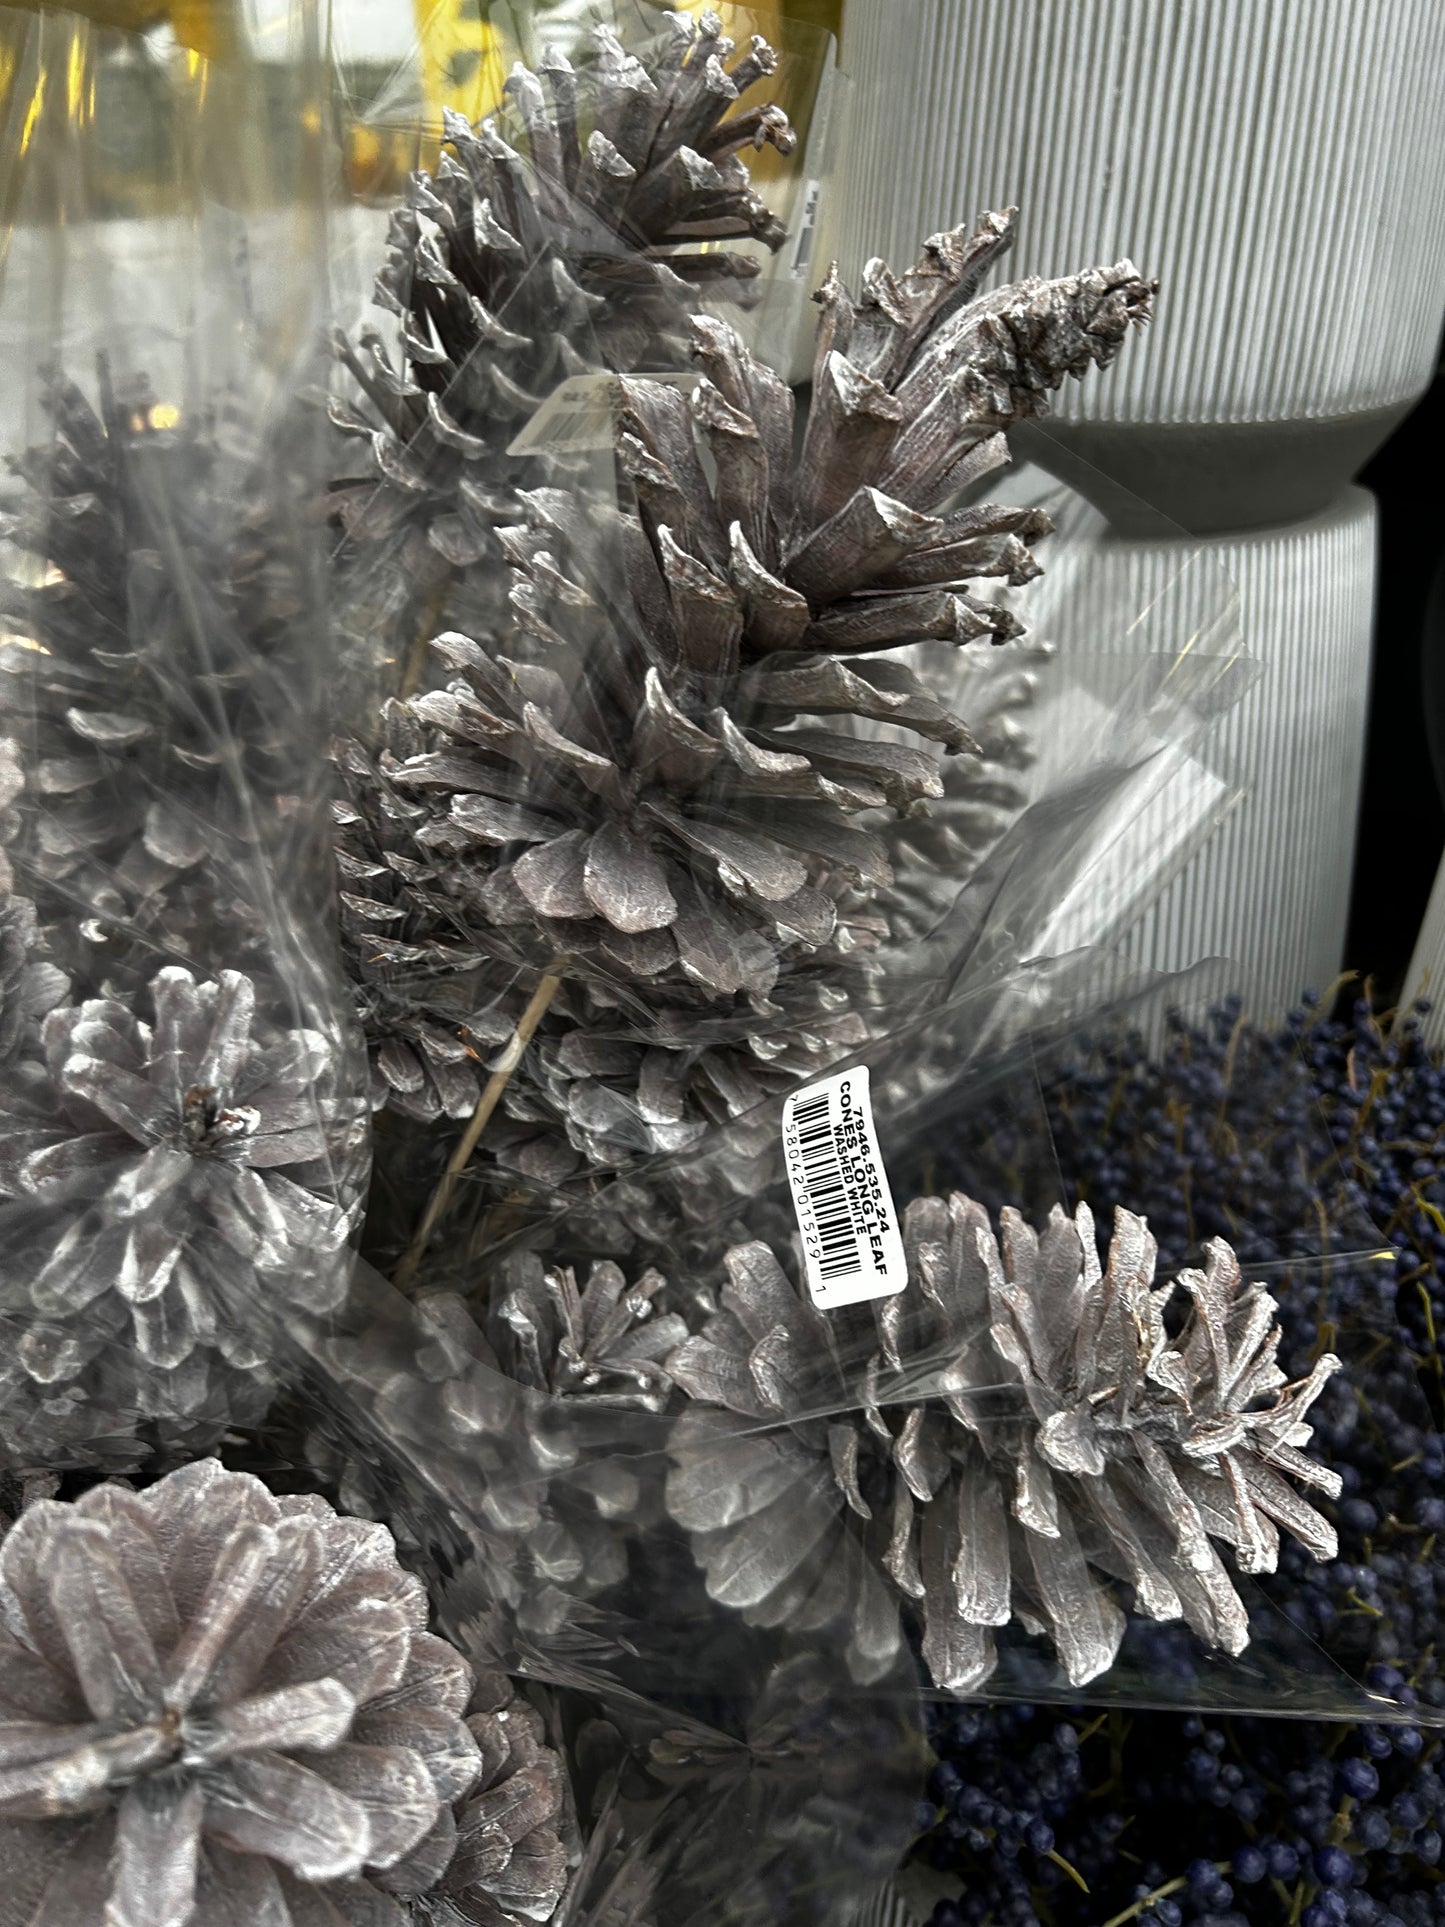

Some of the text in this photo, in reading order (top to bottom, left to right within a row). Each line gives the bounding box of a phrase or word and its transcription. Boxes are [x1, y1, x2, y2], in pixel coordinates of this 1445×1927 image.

[786, 1125, 804, 1185] 58042
[797, 1195, 821, 1259] 01529
[833, 1124, 867, 1234] WASHED WHITE
[840, 1081, 887, 1275] CONES LONG LEAF
[853, 1106, 890, 1233] 7946.535.24
